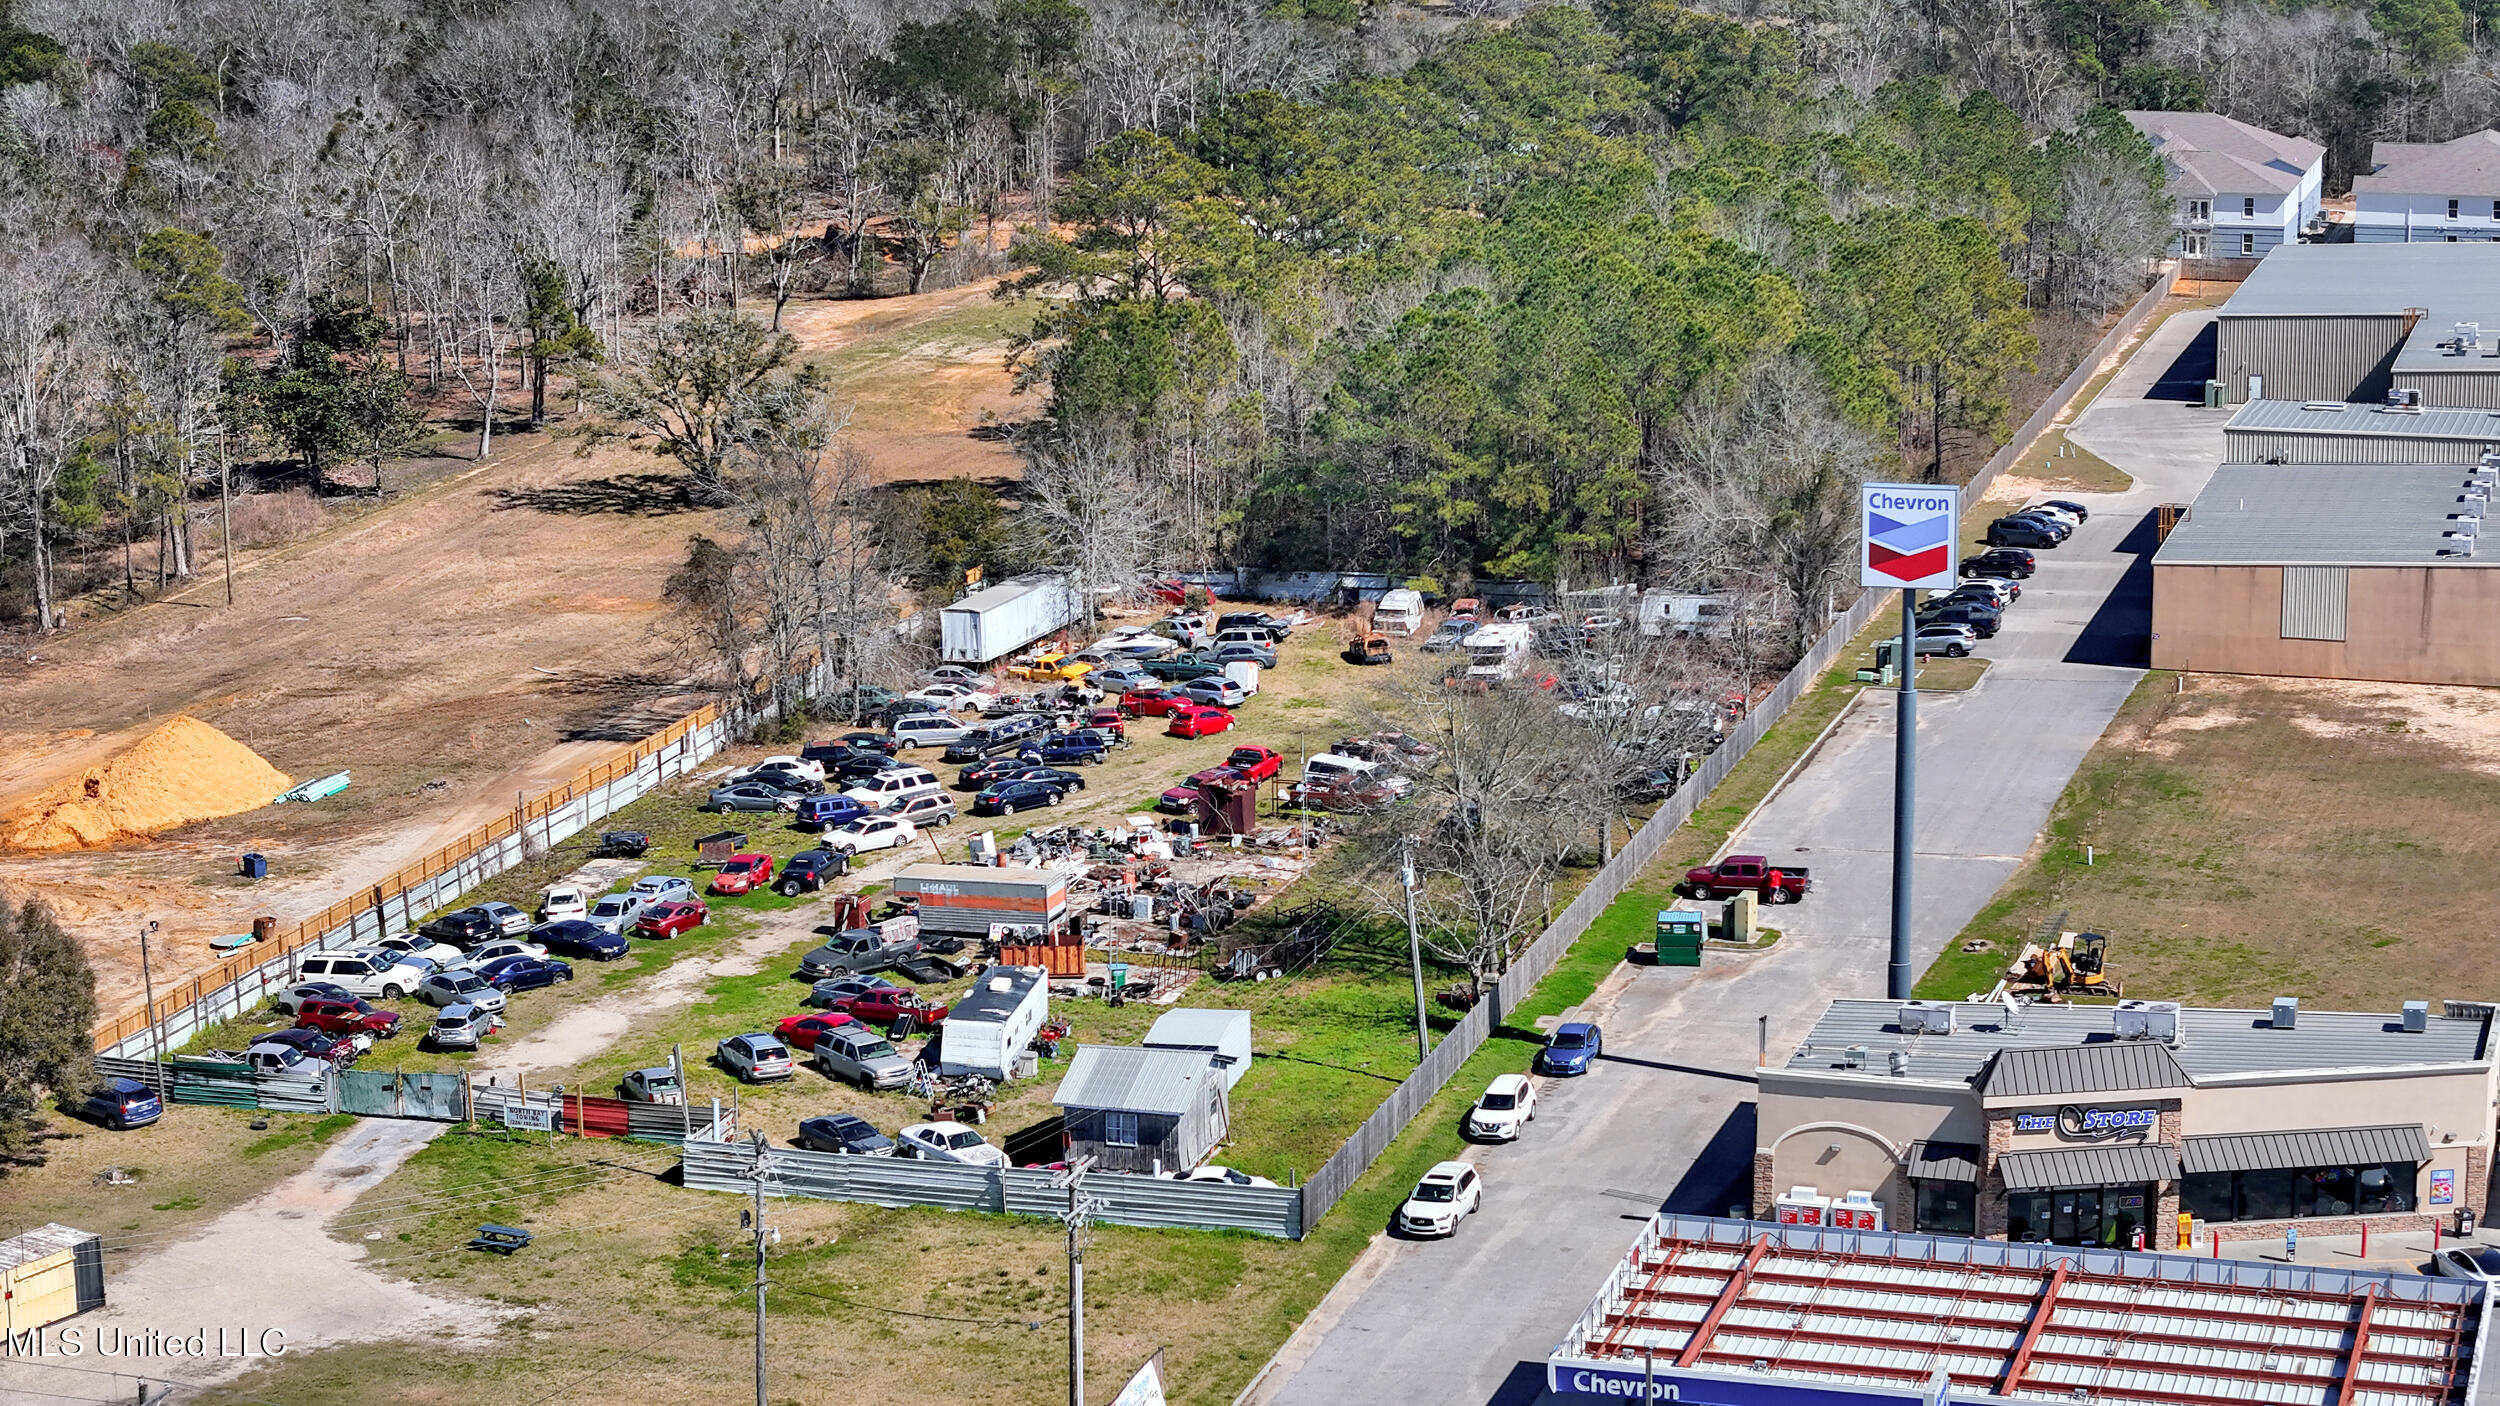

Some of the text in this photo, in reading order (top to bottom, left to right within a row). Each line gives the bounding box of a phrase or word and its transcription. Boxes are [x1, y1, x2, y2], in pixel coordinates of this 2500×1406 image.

[1869, 492, 1949, 511] Chevron
[2017, 1113, 2056, 1131] THE
[2083, 1108, 2157, 1130] STORE
[1573, 1370, 1680, 1401] Chevron
